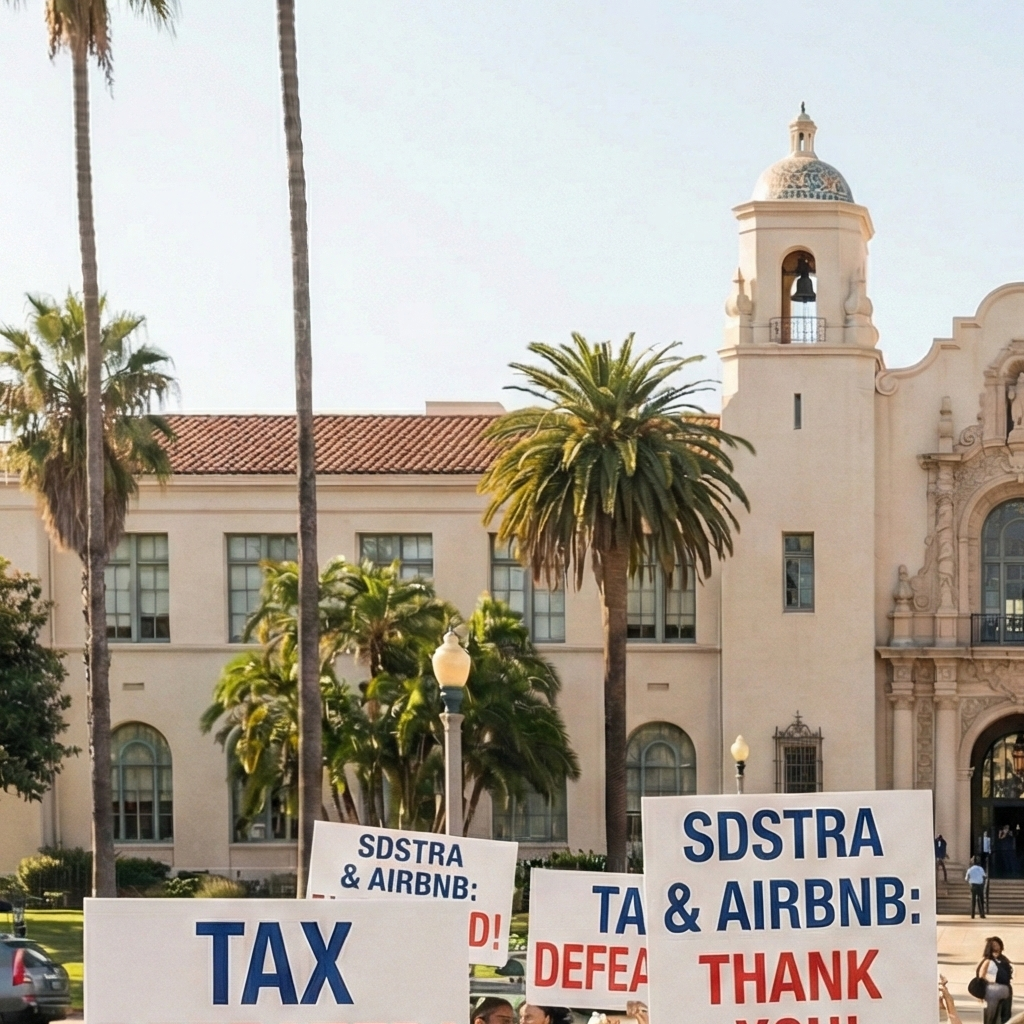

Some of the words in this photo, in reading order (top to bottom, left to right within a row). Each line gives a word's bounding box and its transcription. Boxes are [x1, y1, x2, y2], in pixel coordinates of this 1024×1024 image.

[358, 834, 463, 867] SDSTRA
[683, 807, 884, 863] SDSTRA
[340, 863, 360, 889] &
[367, 867, 478, 901] AIRBNB:
[664, 882, 701, 934] &
[717, 876, 920, 932] AIRBNB:
[195, 921, 354, 1005] TAX
[698, 949, 882, 1005] THANK
